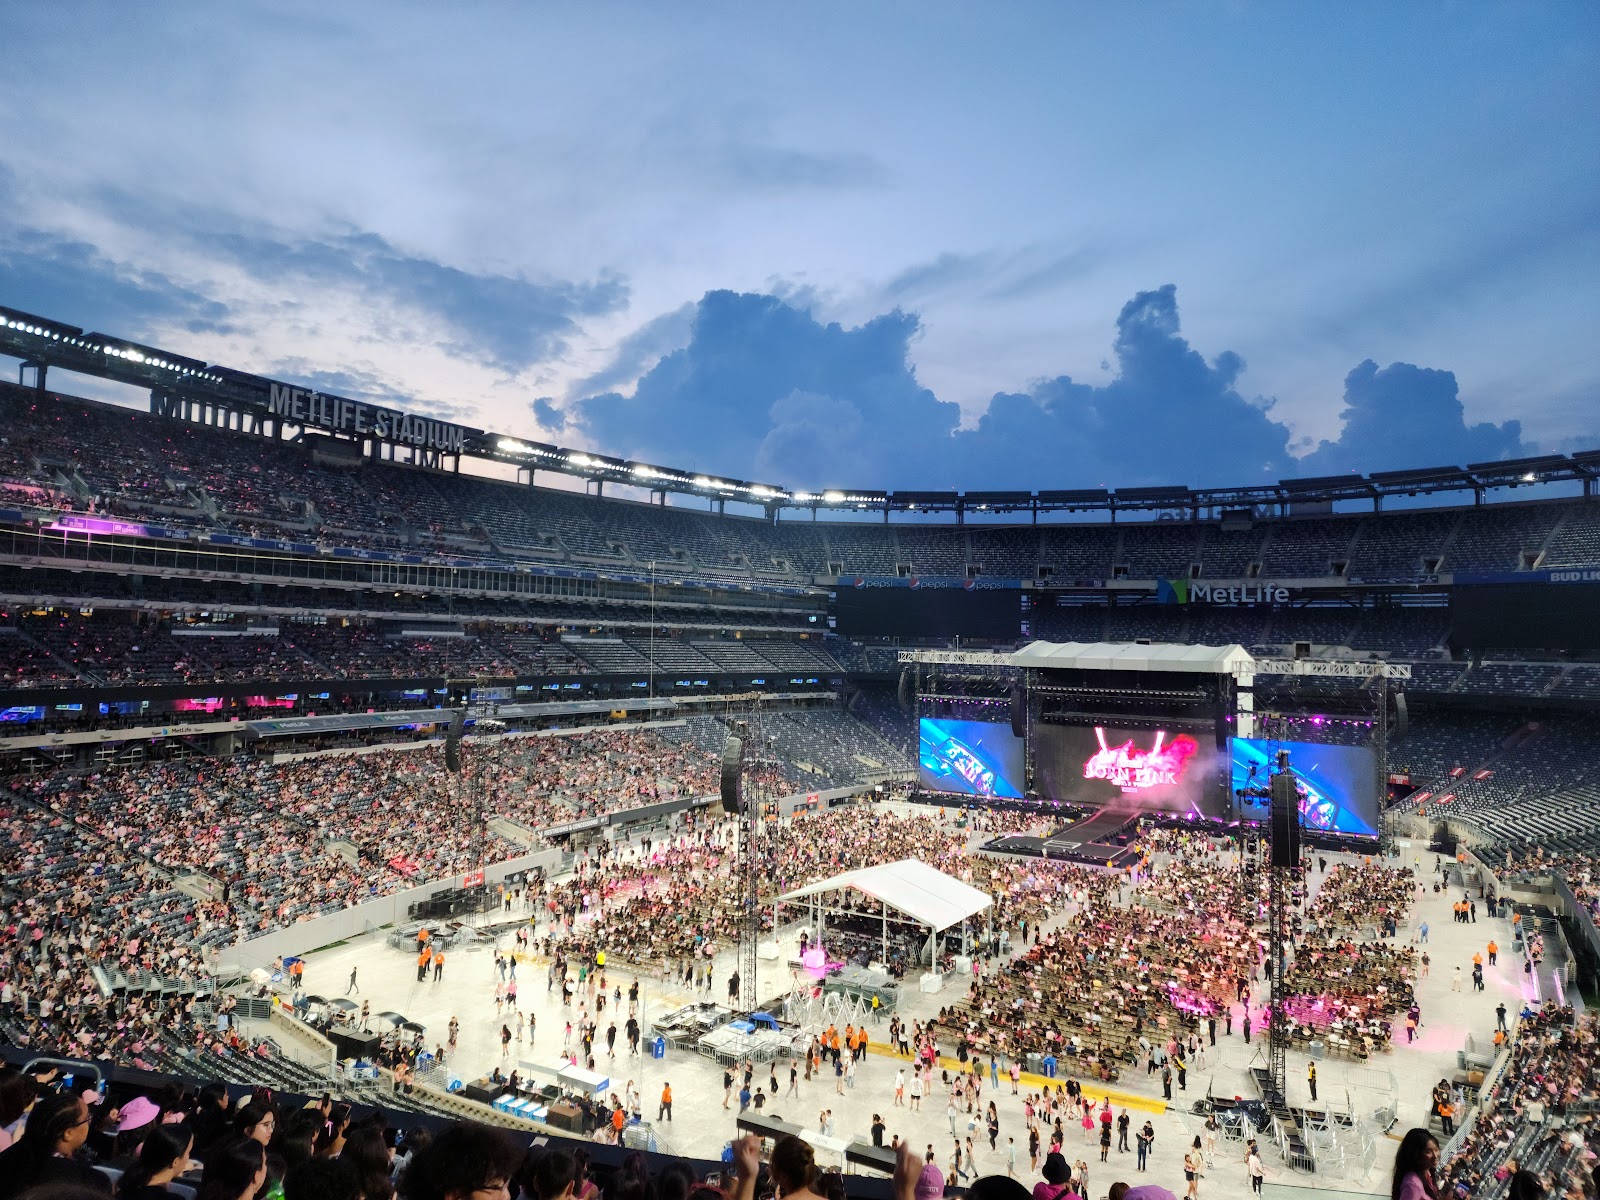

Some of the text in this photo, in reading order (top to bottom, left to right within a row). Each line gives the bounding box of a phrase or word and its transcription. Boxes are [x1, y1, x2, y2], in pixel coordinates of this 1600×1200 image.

[268, 383, 368, 433] METLIFE
[374, 410, 464, 453] STADIUM
[1550, 572, 1581, 582] BUD
[866, 579, 893, 588] pepsi
[920, 580, 948, 589] pepsi
[975, 581, 1004, 591] pepsi
[1190, 582, 1290, 603] MetLife
[543, 825, 568, 836] RESTROOMS
[572, 818, 598, 830] CONCESSIONS
